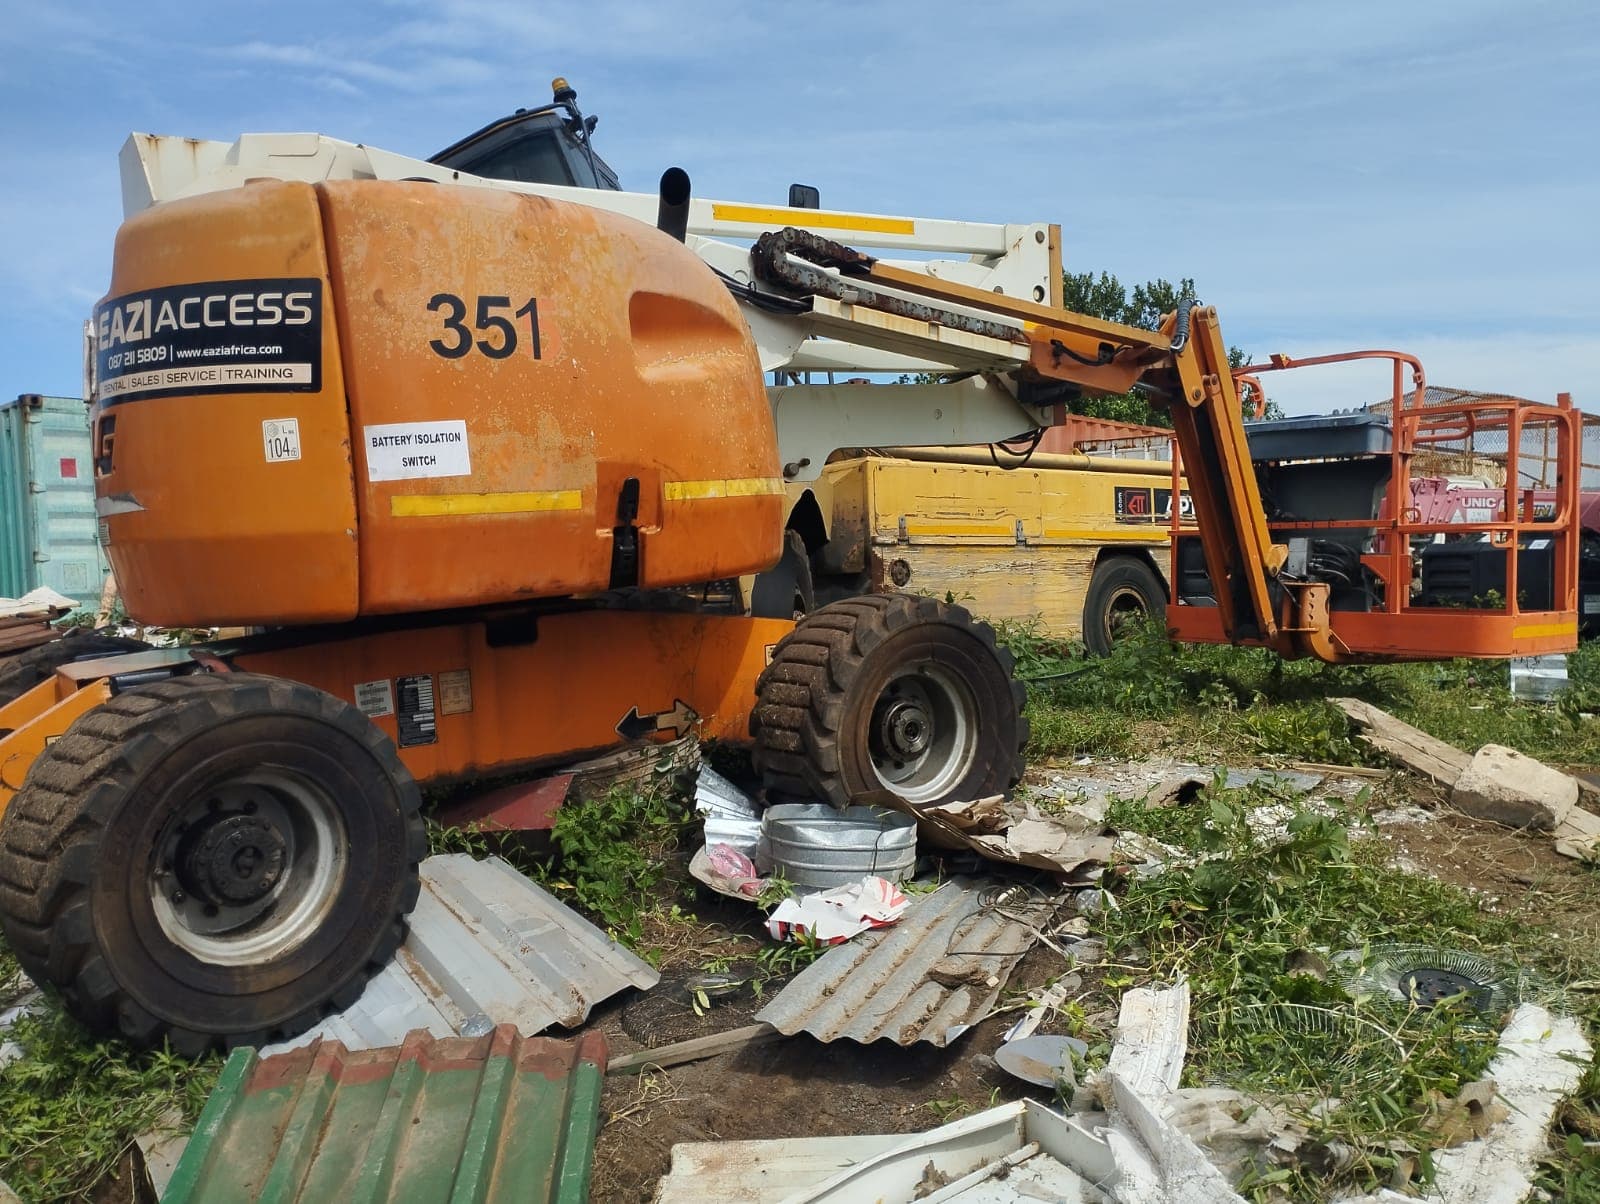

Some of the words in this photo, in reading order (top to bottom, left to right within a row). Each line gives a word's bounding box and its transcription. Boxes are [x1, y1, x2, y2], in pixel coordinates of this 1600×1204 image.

[98, 299, 152, 351] EAZI
[154, 292, 313, 333] ACCESS
[427, 293, 542, 360] 351
[108, 354, 122, 370] 087
[124, 351, 135, 366] 211
[137, 346, 167, 364] 5809
[176, 345, 283, 359] www.eaziafrica.com
[131, 374, 160, 388] SALES
[166, 367, 216, 384] SERVICE
[225, 368, 293, 380] TRAINING
[268, 437, 290, 458] 104
[371, 434, 413, 447] BATTERY
[414, 431, 461, 445] ISOLATION
[402, 455, 437, 468] SWITCH
[1461, 497, 1497, 509] UNIC
